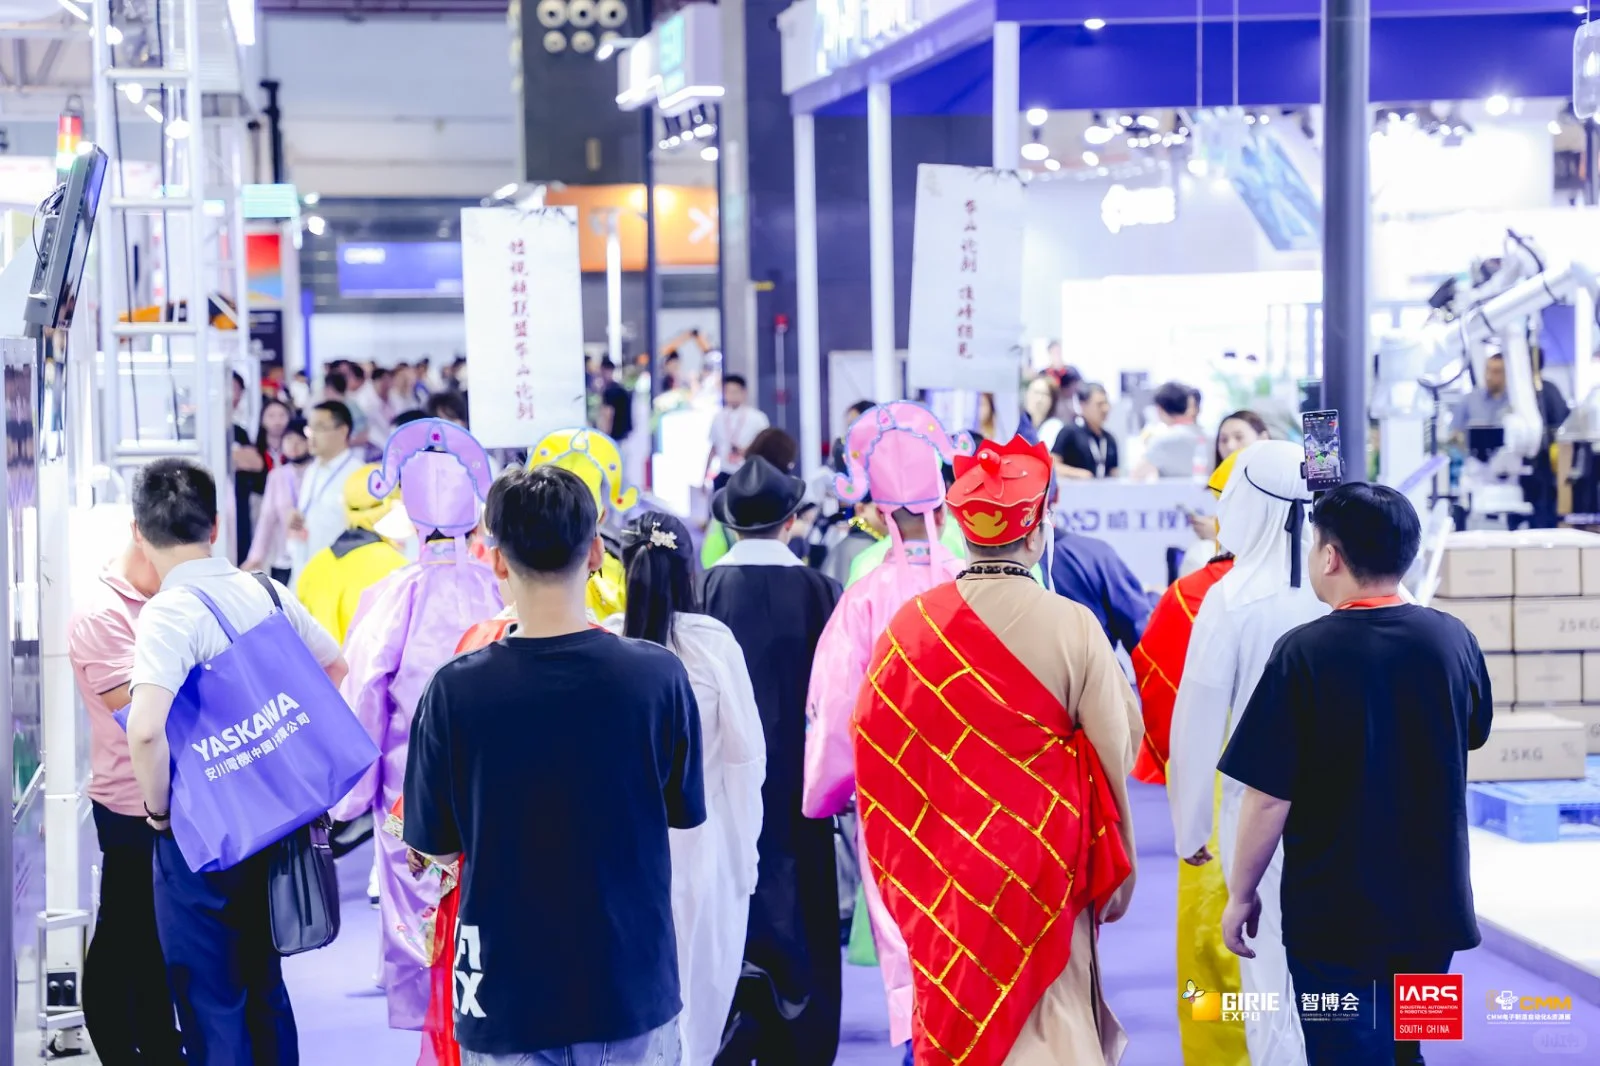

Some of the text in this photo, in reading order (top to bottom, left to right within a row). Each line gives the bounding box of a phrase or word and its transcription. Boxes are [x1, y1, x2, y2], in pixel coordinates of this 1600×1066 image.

[1558, 617, 1600, 633] 25KG
[192, 692, 300, 762] YASKAWA
[1501, 748, 1544, 762] 25KG
